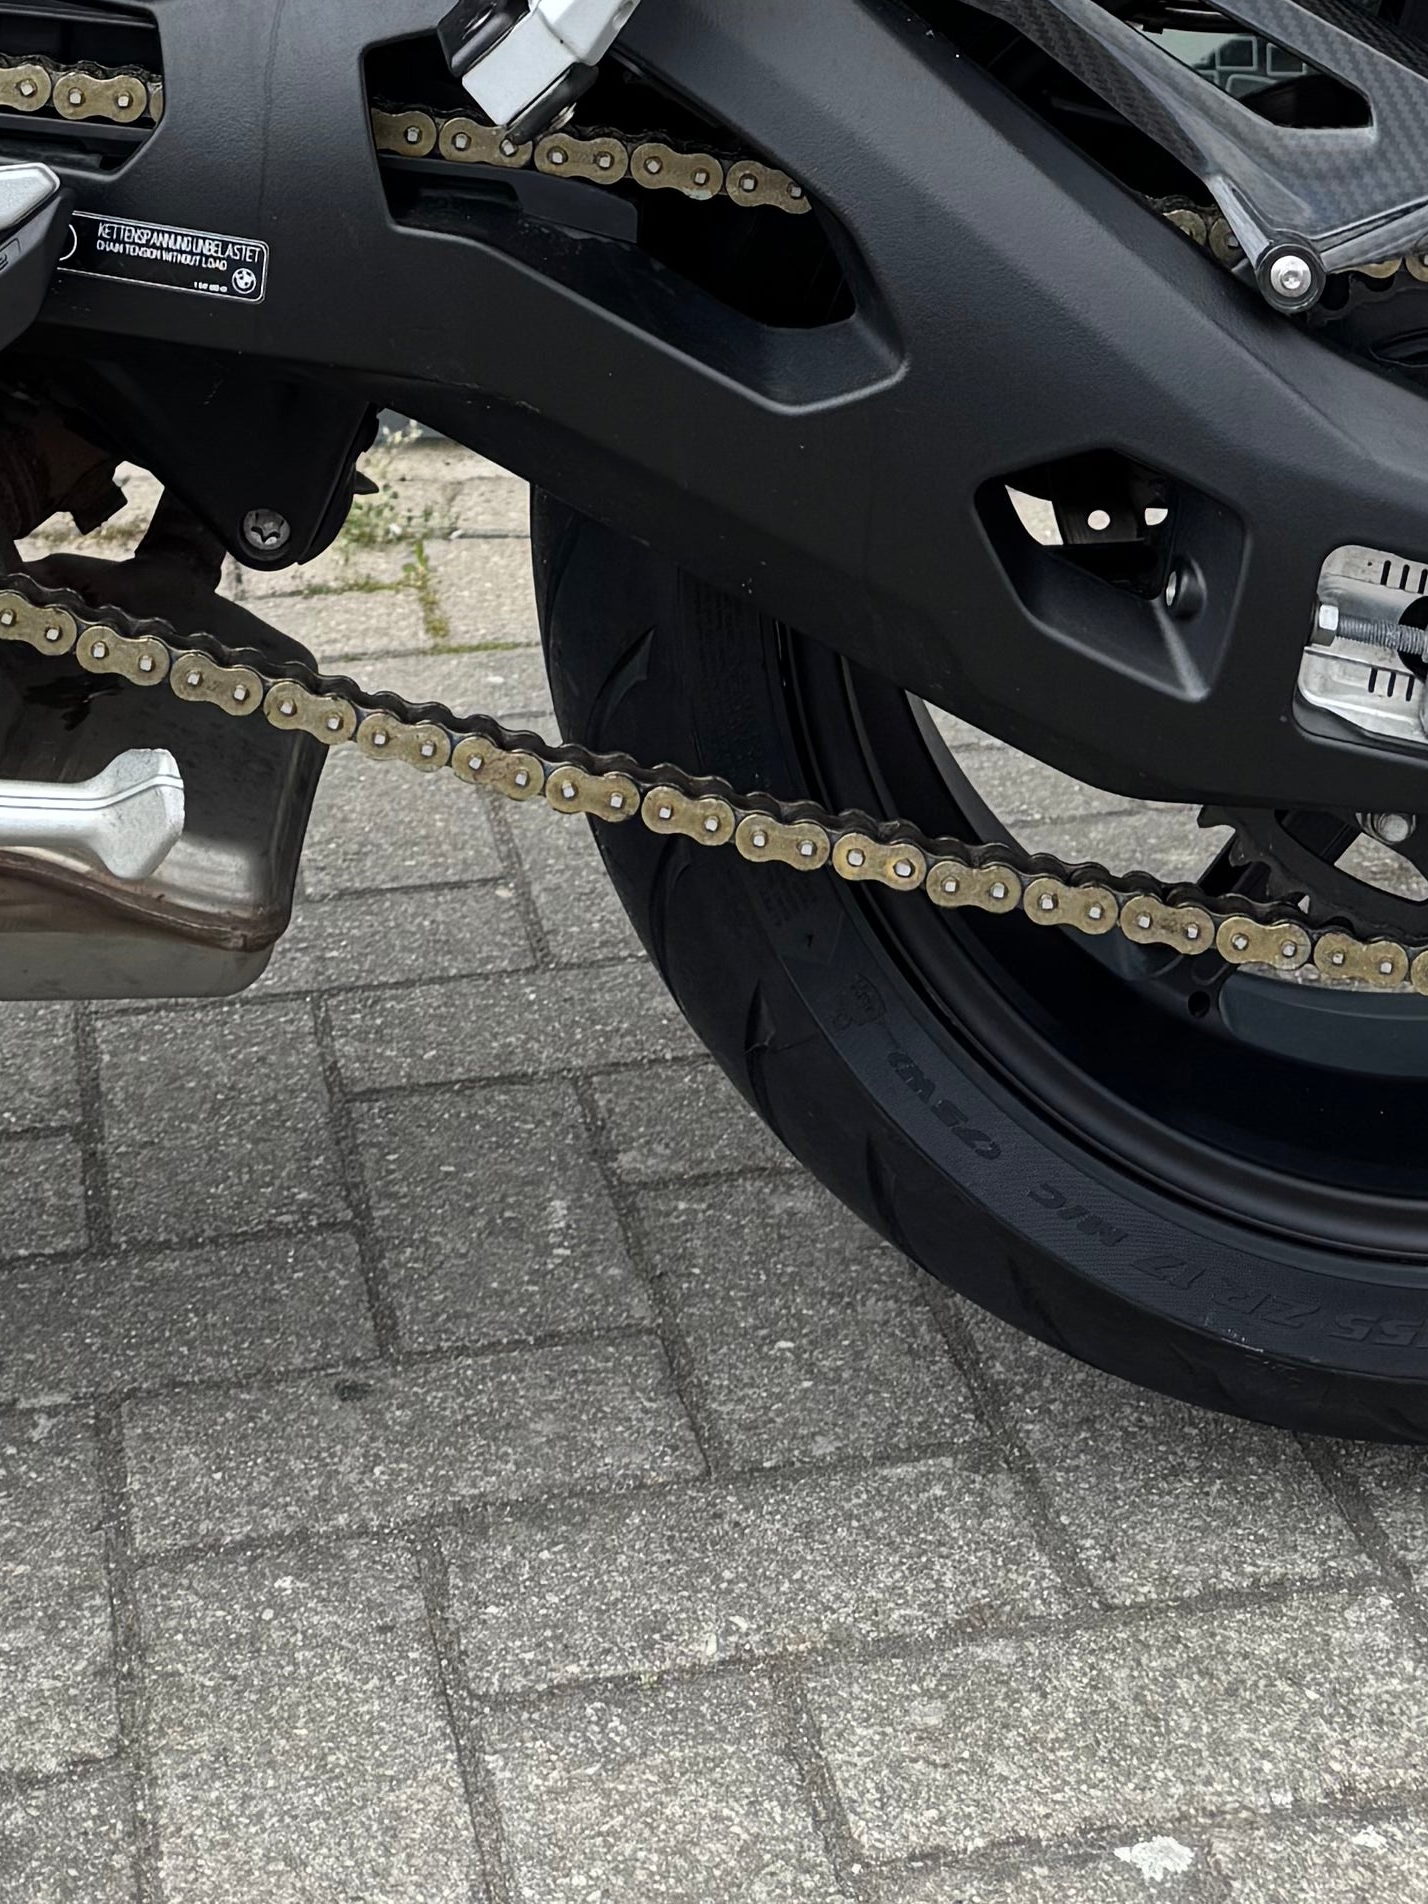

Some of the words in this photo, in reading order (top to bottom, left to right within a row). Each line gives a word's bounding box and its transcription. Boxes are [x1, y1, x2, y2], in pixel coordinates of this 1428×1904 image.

[96, 240, 125, 254] CHAIN
[162, 248, 200, 266] WITHOUT
[202, 256, 227, 271] LOAD
[192, 238, 261, 263] UNBELASTET
